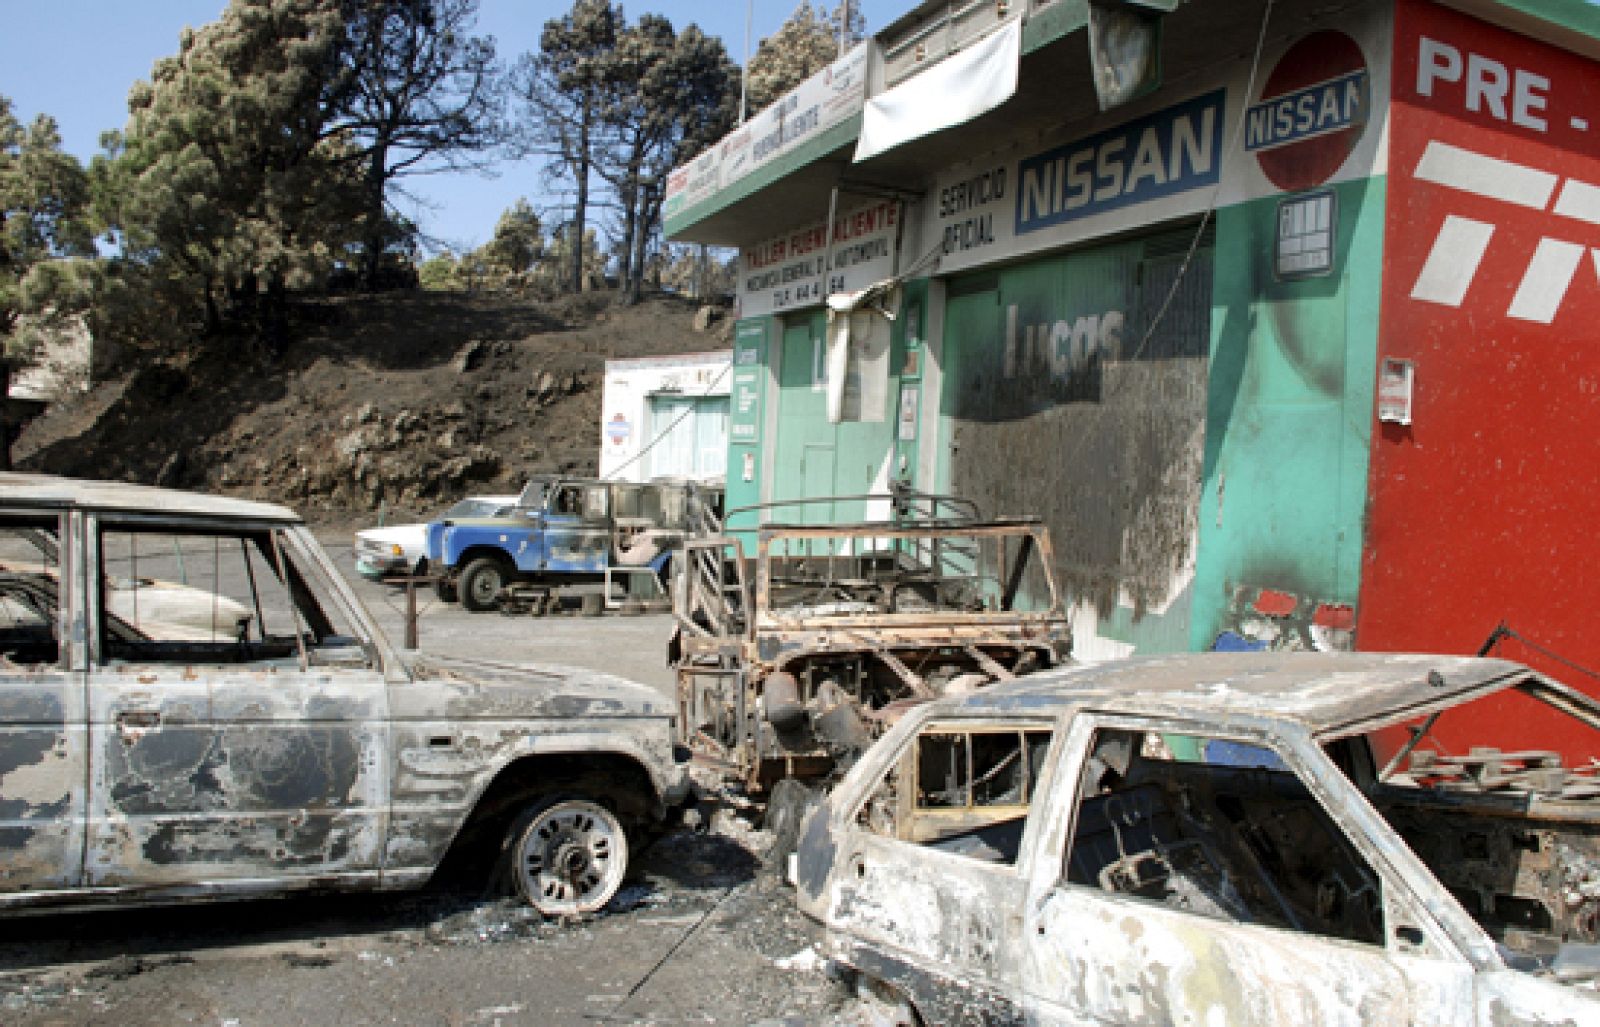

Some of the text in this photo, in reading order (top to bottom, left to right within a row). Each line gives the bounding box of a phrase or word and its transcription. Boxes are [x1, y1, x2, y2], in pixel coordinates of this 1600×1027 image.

[1247, 80, 1361, 147] NISSAN
[1416, 35, 1550, 132] PRE
[939, 167, 1006, 220] SERVICIO
[1021, 105, 1217, 223] NISSAN
[789, 202, 898, 257] FUENALIENTE
[943, 213, 995, 256] OFICIAL
